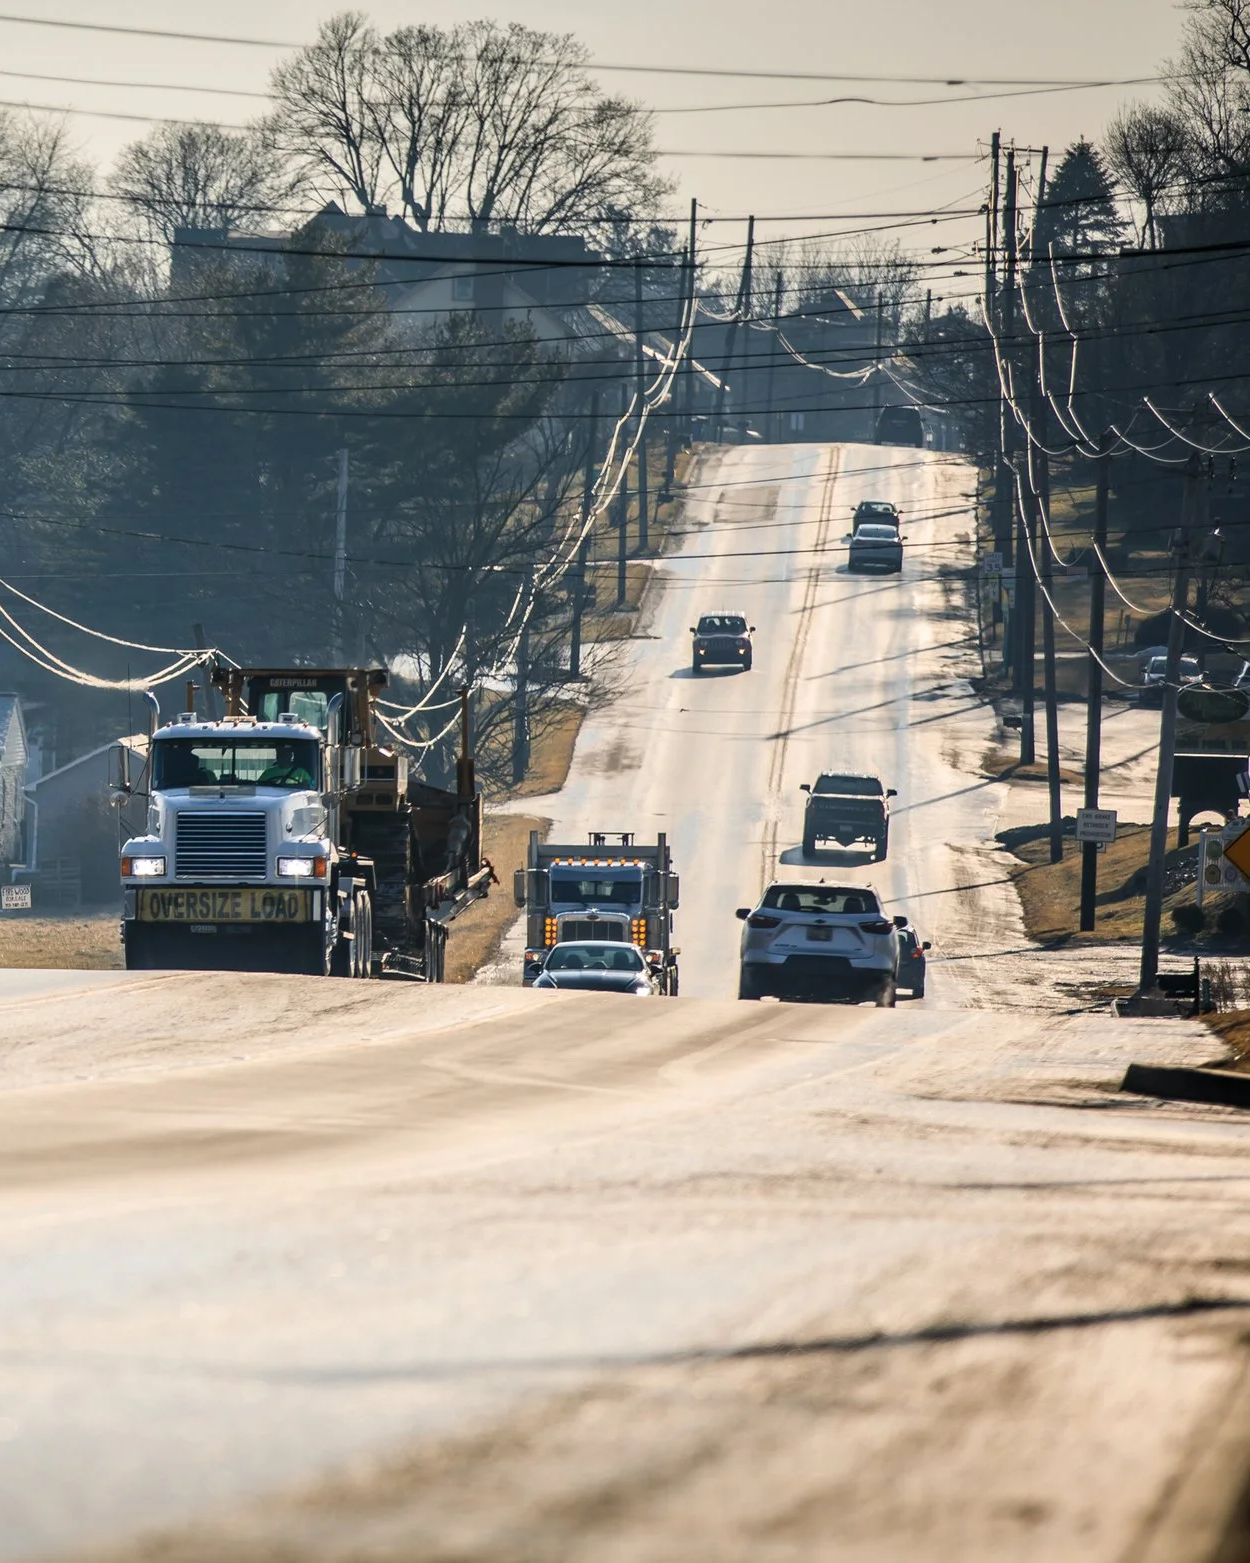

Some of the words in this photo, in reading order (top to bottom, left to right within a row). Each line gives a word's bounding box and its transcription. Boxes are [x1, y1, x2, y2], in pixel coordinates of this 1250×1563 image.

[270, 678, 317, 687] CATERPILLAR
[150, 892, 242, 918] OVERSIZE
[250, 892, 299, 918] LOAD
